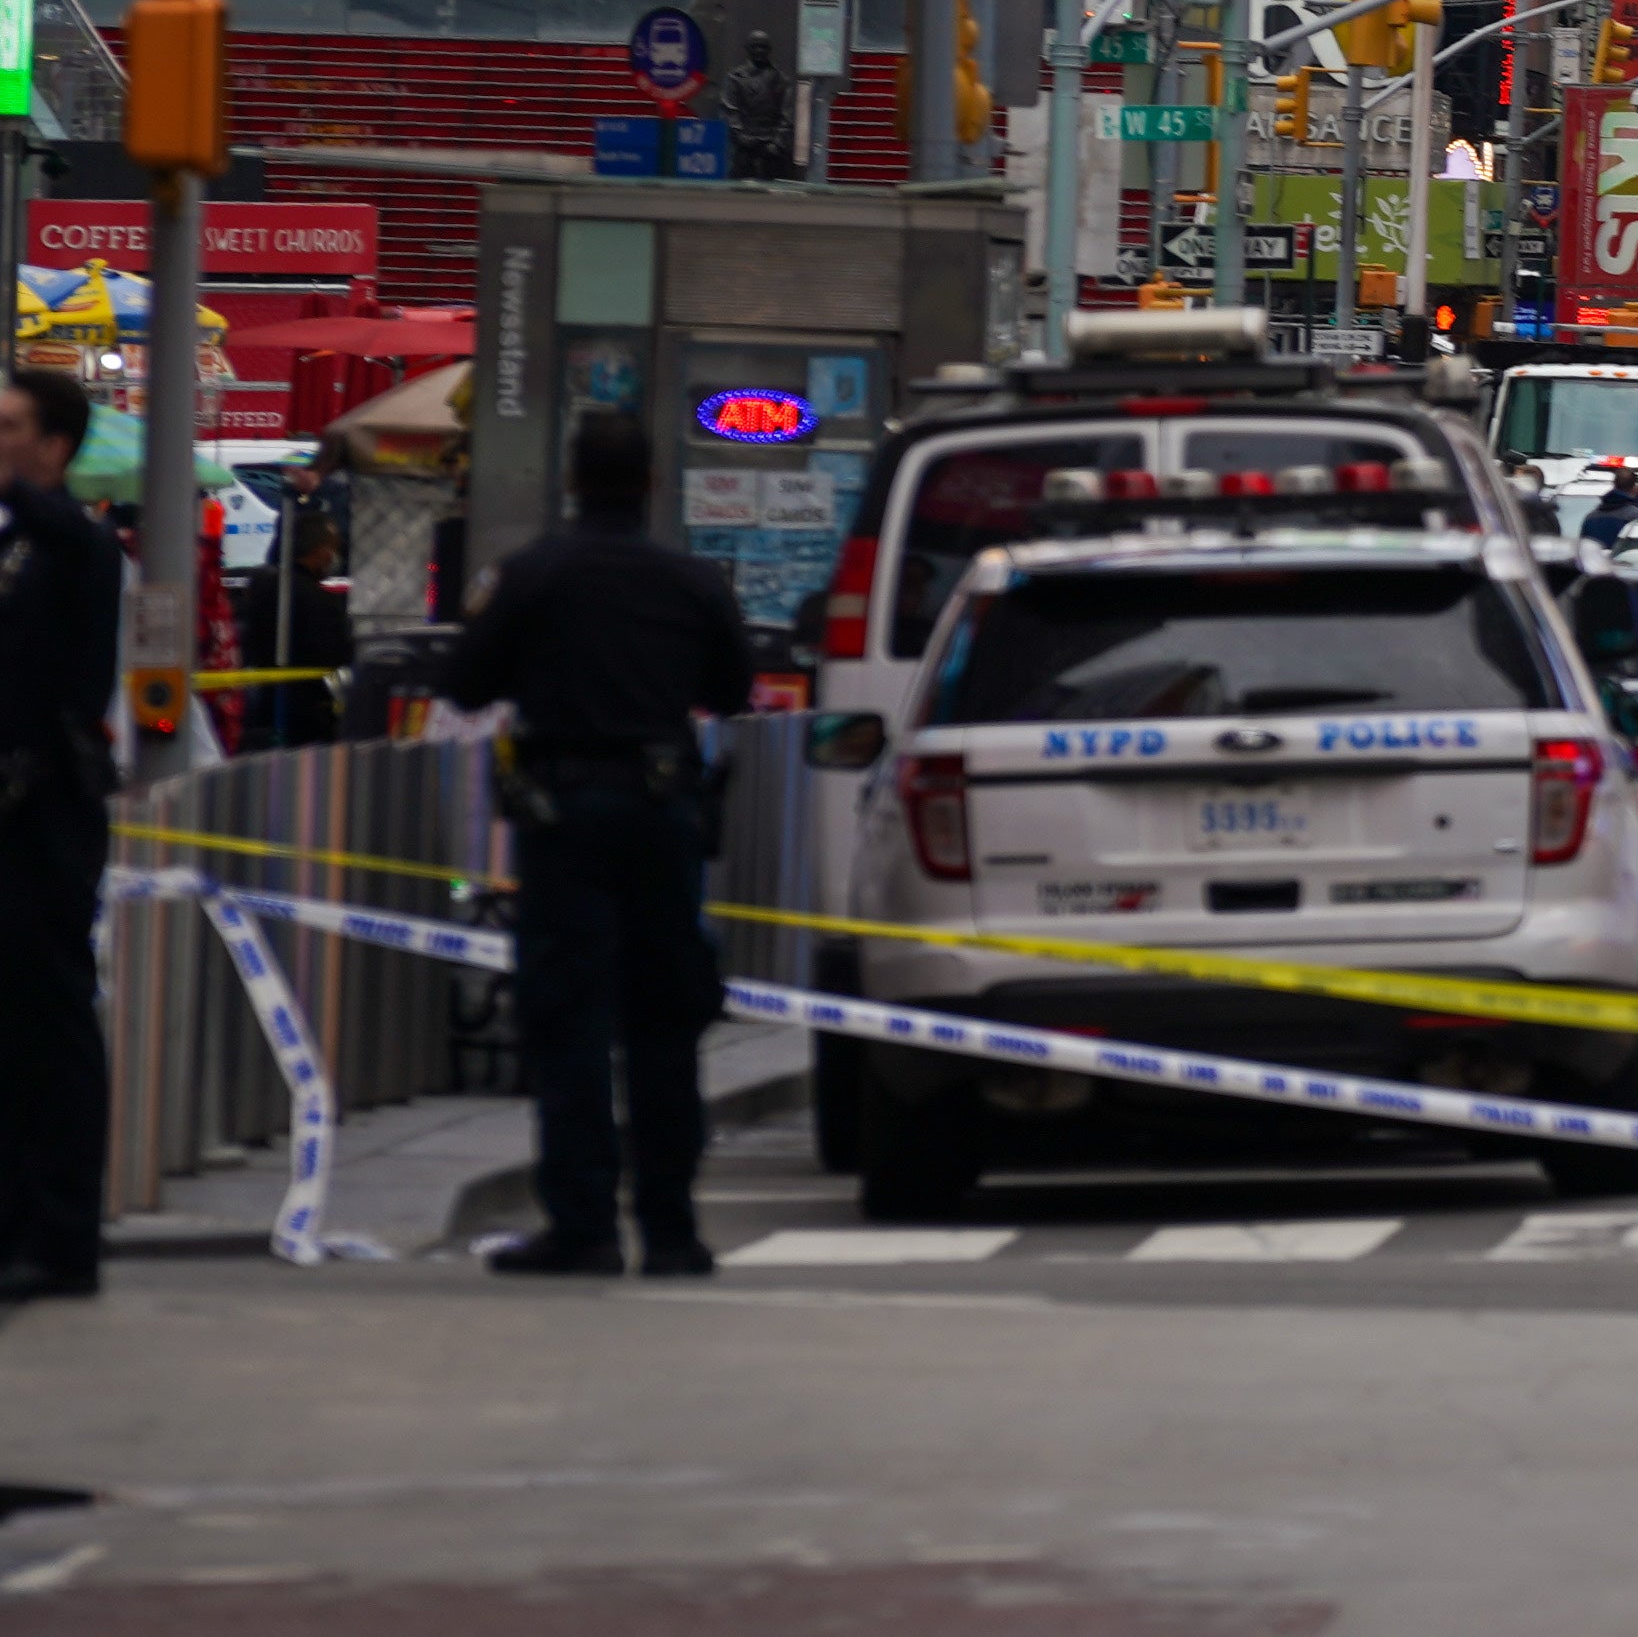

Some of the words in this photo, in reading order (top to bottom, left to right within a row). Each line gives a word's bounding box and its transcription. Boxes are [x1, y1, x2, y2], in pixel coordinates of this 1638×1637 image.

[1100, 33, 1122, 56] 45
[1123, 110, 1146, 135] W
[1156, 109, 1185, 136] 45
[39, 225, 149, 250] COFFE
[205, 228, 268, 253] SWEET
[273, 228, 364, 255] CHURROS
[1179, 237, 1216, 256] ONE
[499, 246, 533, 418] Newsstand
[717, 396, 799, 433] ATM
[1041, 728, 1167, 760] NYPD
[1317, 721, 1481, 751] POLICE
